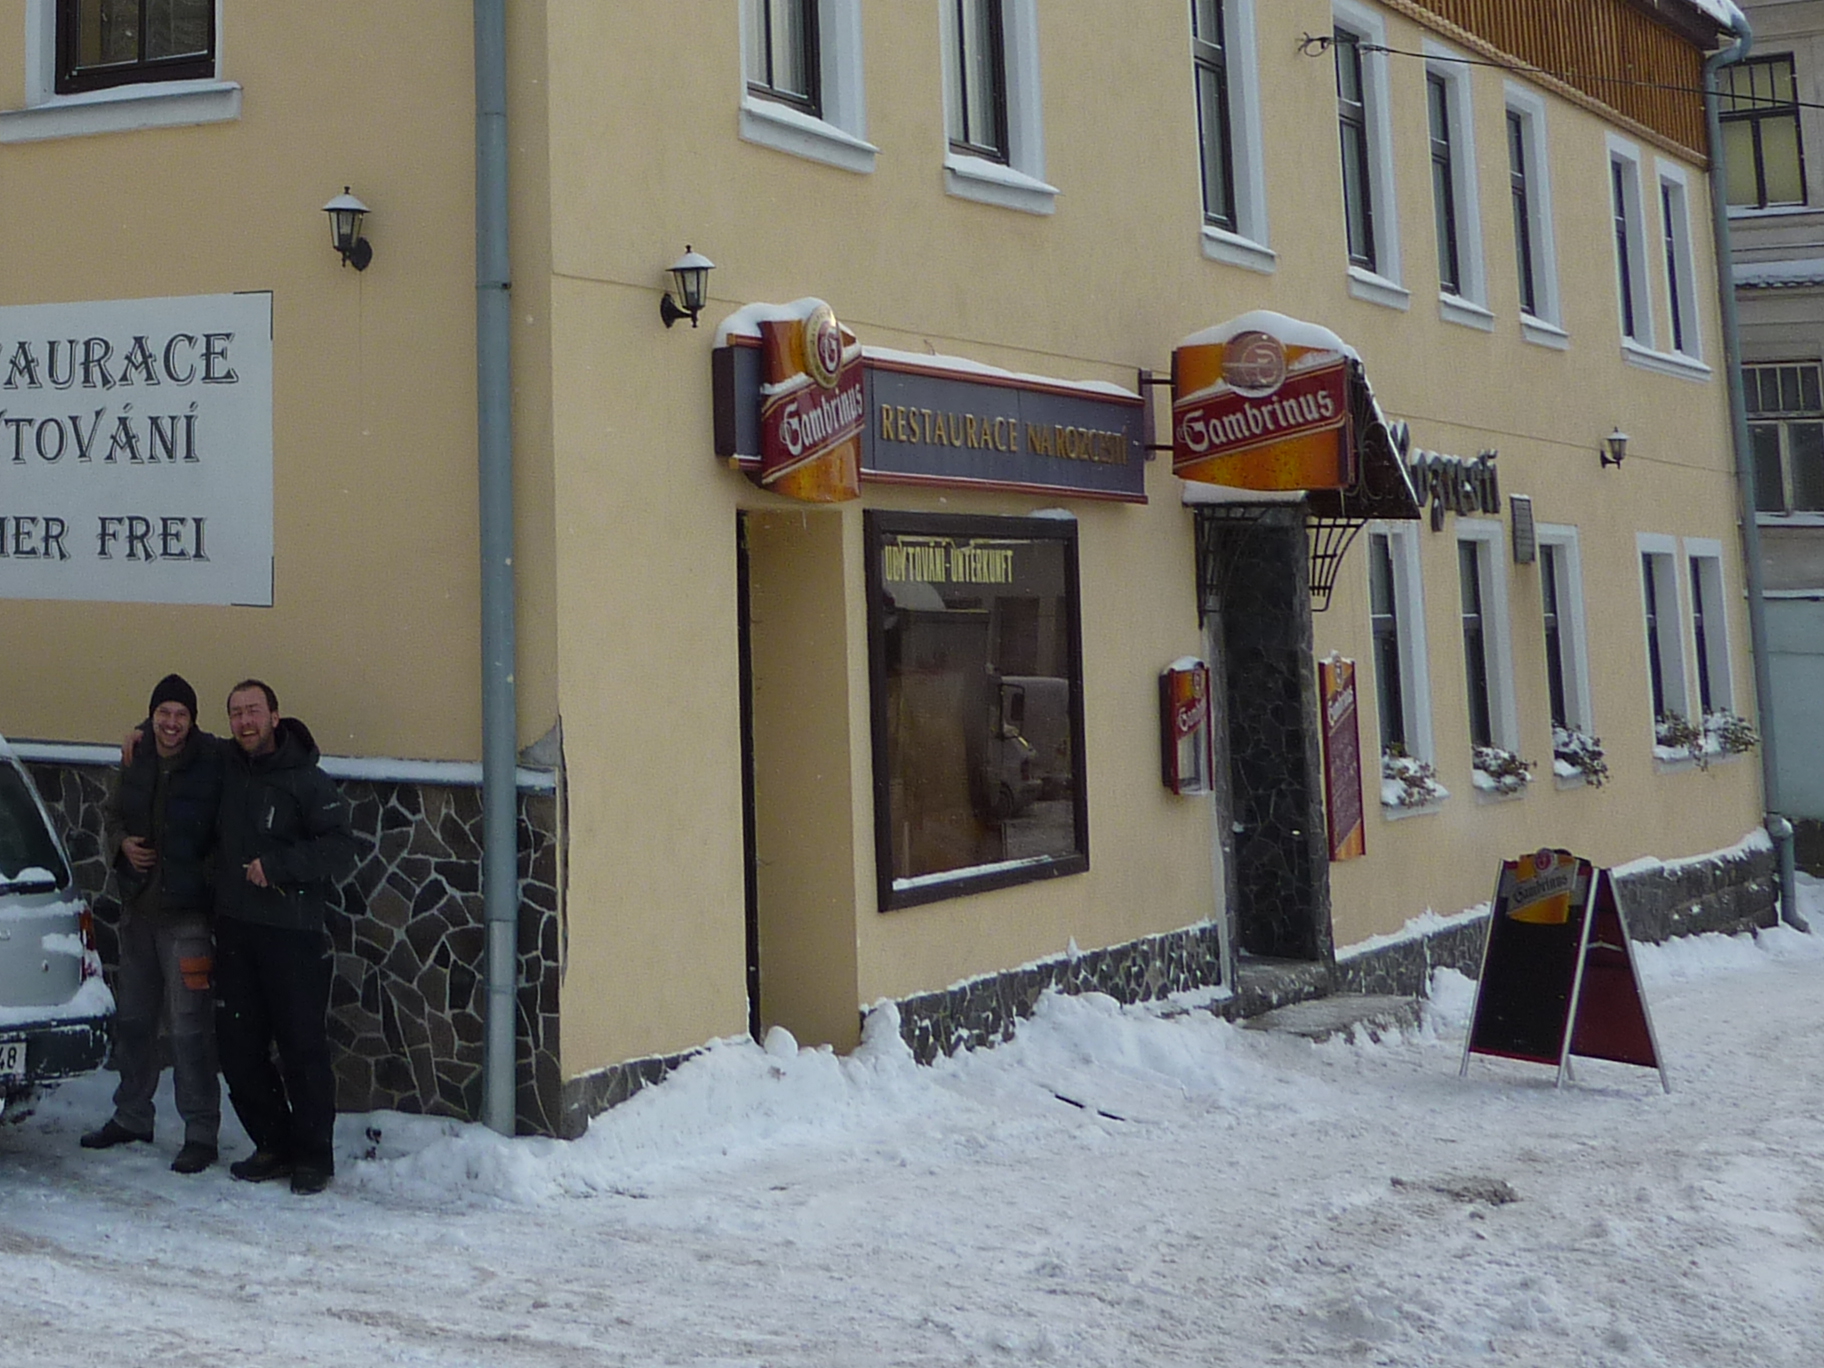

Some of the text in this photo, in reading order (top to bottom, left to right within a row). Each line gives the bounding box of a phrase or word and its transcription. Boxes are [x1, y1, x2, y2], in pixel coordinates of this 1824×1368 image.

[779, 384, 863, 456] Gambrinus
[881, 404, 1018, 453] RESTAURACE
[1027, 422, 1053, 456] NA
[1176, 390, 1334, 452] Gambrinus
[96, 516, 211, 563] FREI
